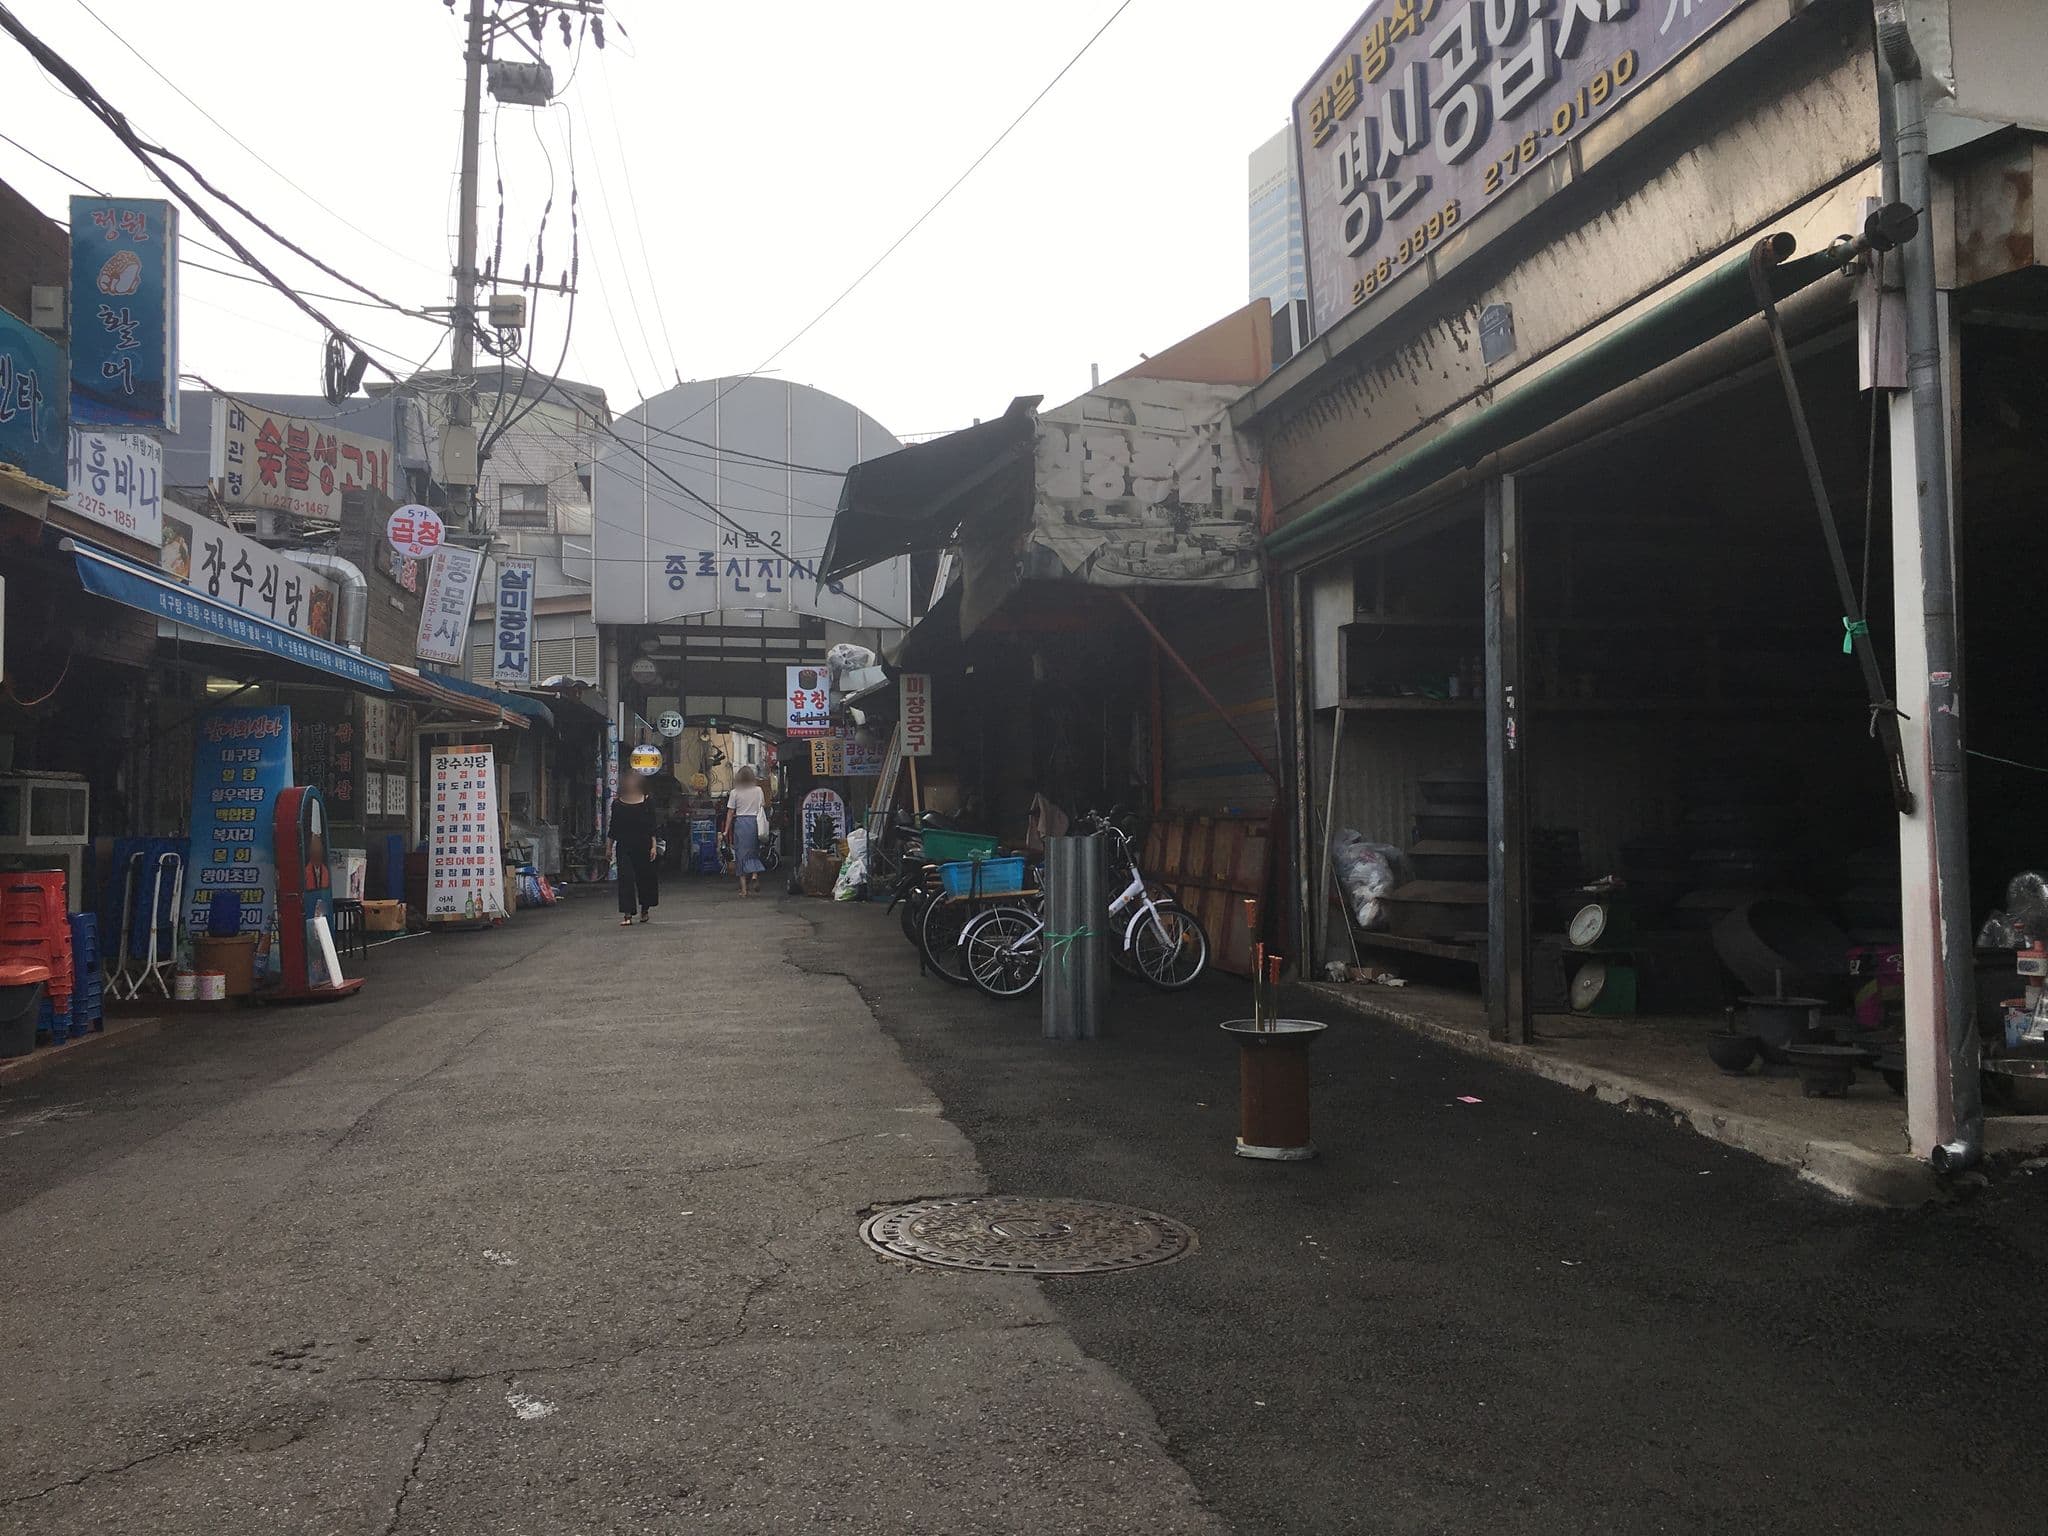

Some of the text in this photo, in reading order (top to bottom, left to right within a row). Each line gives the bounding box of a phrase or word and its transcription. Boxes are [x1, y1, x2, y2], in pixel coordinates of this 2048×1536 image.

[1484, 49, 1638, 195] 276-0190
[92, 208, 149, 242] 정원
[1352, 198, 1459, 305] 266-9896
[77, 491, 137, 530] 2275-1851
[408, 509, 430, 521] 5가
[391, 517, 442, 547] 곱창
[723, 530, 783, 549] 서문 2
[201, 537, 303, 628] 장수식당
[433, 555, 472, 648] 동문사
[498, 569, 532, 673] 삼미공업사
[789, 689, 828, 710] 곱창
[906, 677, 926, 752] 미장공구
[221, 748, 261, 762] 대구탕
[435, 755, 488, 770] 장수식당
[437, 769, 487, 780] 삼겹살
[437, 780, 487, 792] 닭도리탕
[202, 868, 259, 884] 광어초밥
